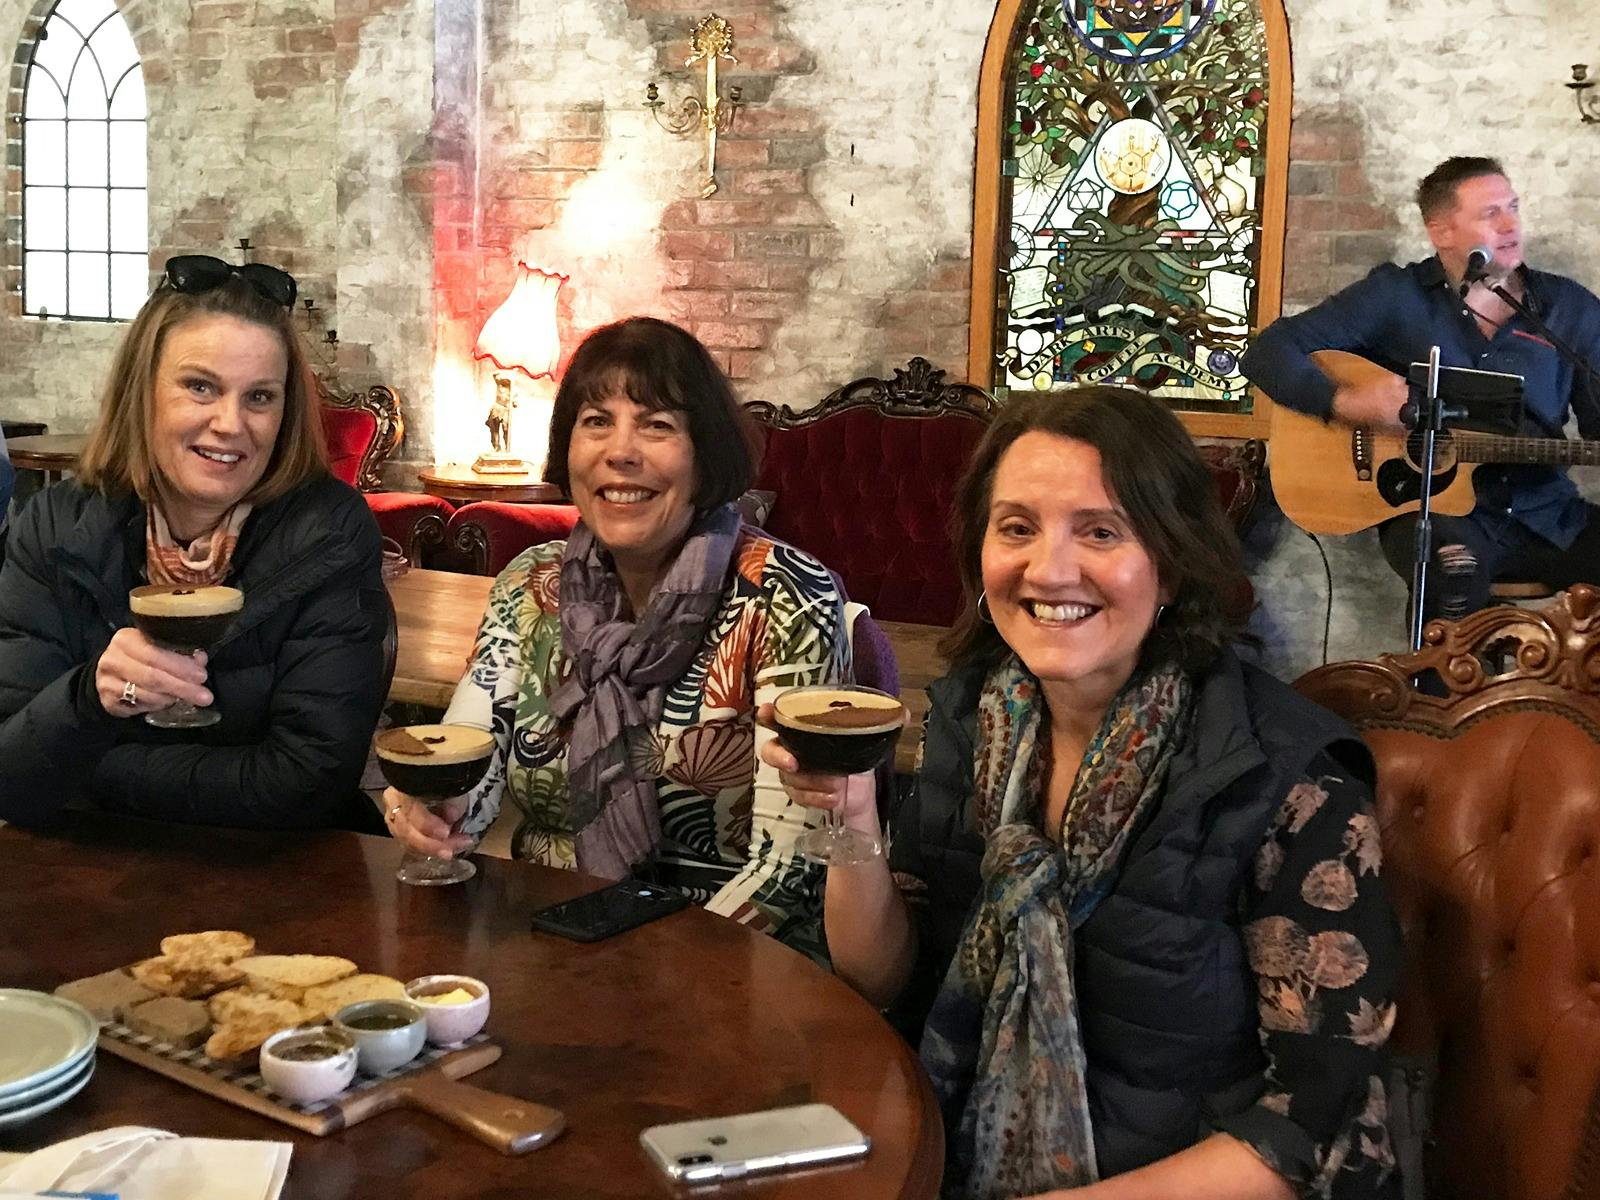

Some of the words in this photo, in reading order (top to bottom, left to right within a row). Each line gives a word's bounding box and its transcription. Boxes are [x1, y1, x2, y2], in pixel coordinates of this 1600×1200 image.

[1027, 336, 1072, 374] DARK
[1082, 324, 1132, 341] ARTS
[1087, 340, 1144, 381] COFFEE
[1151, 353, 1233, 388] ACADEMY
